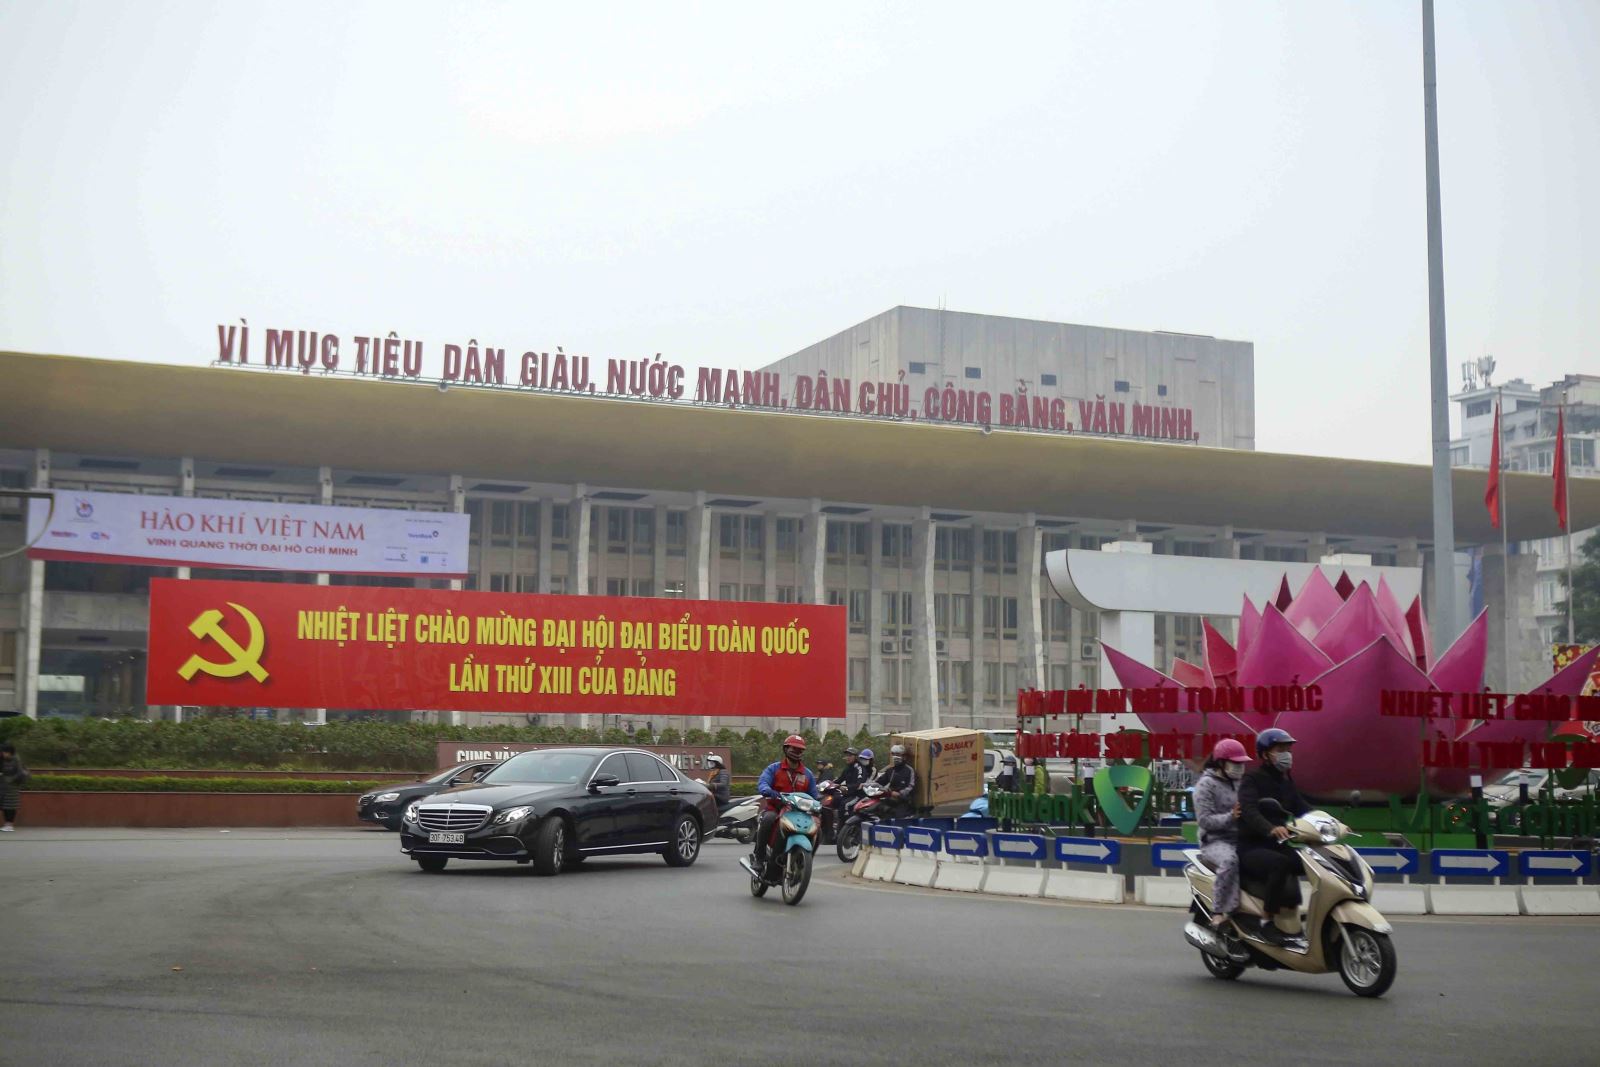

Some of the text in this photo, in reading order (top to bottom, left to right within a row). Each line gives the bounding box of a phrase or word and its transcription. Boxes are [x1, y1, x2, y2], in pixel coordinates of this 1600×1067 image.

[217, 318, 248, 363] VÌ
[265, 328, 339, 374] MỤC
[354, 331, 424, 377] TIÊU
[443, 339, 505, 384] DÂN
[607, 353, 685, 399] NƯỚC
[796, 369, 851, 413] DÂN
[859, 369, 917, 421] CHỦ,
[924, 381, 991, 425] CÔNG
[1079, 393, 1125, 433] VĂN
[140, 508, 365, 541] HÀO KHÍ VIỆT NAM
[146, 537, 177, 548] VINH
[180, 539, 225, 551] QUANG
[329, 547, 359, 557] MINH
[297, 605, 810, 657] NHIỆT LIỆT CHÀO MỪNG ĐẠI HỘI ĐẠI BIỂU TOÀN QUỐC
[449, 654, 676, 697] LẦN THỨ XIII CỦA ĐẢNG
[1252, 674, 1323, 715] QUỐC
